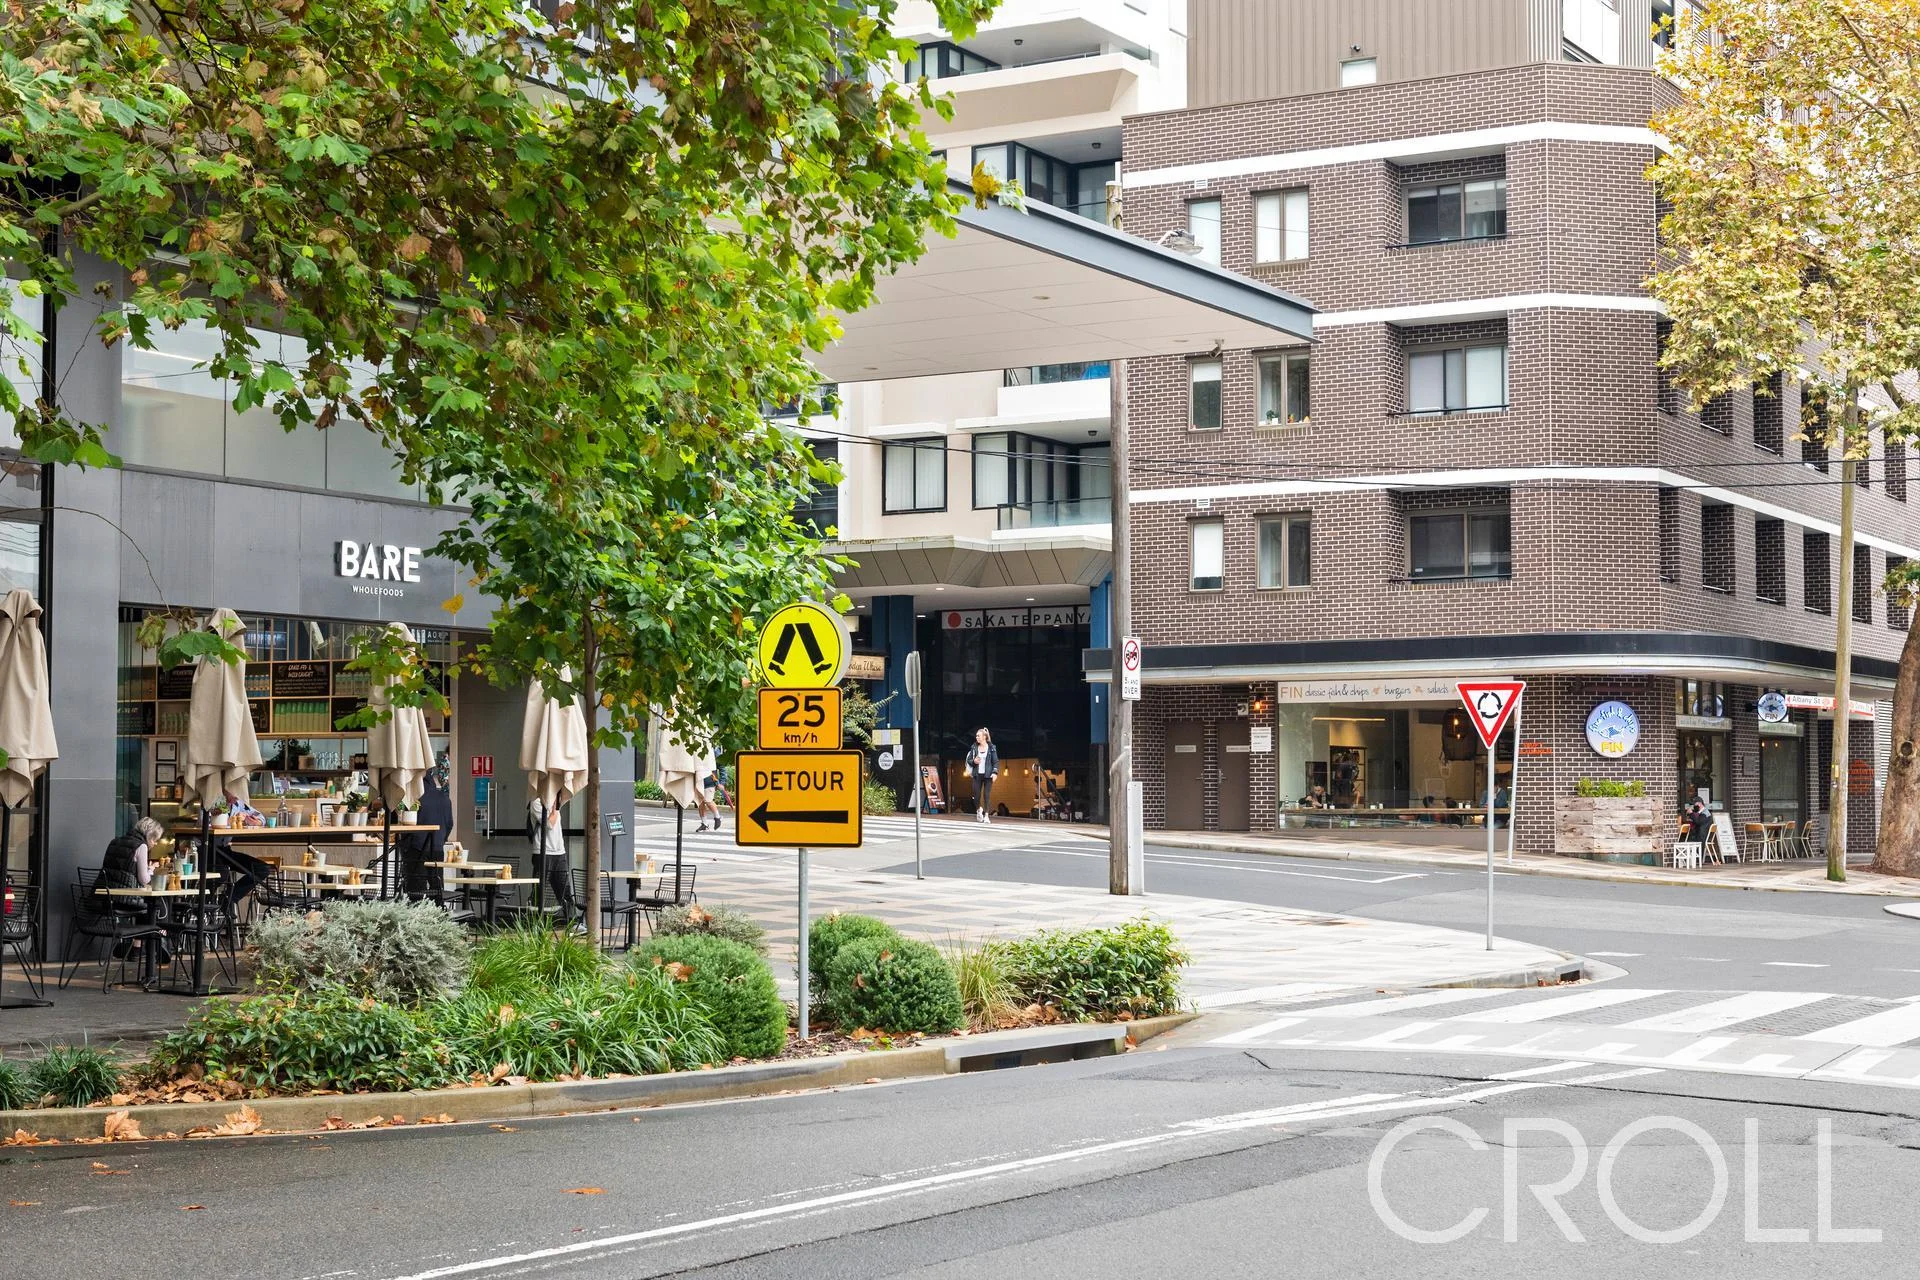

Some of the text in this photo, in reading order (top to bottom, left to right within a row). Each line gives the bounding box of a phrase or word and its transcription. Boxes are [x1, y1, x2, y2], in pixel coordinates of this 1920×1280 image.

[341, 540, 421, 583] BARE
[352, 585, 404, 597] WHOLEFOODS
[965, 614, 1006, 628] SAKA
[1124, 686, 1138, 694] OVER
[1280, 686, 1303, 699] FIN
[1305, 684, 1326, 697] classic
[1349, 684, 1369, 700] chips
[1384, 684, 1411, 699] burgers
[1427, 682, 1449, 694] salads
[1792, 695, 1812, 704] Albany
[1813, 696, 1821, 704] St
[777, 695, 825, 728] 25
[1599, 705, 1616, 720] fish
[1616, 706, 1623, 720] &
[1764, 712, 1778, 720] FIN
[783, 732, 818, 744] km/h
[1600, 740, 1624, 753] FIN
[754, 770, 844, 791] DETOUR
